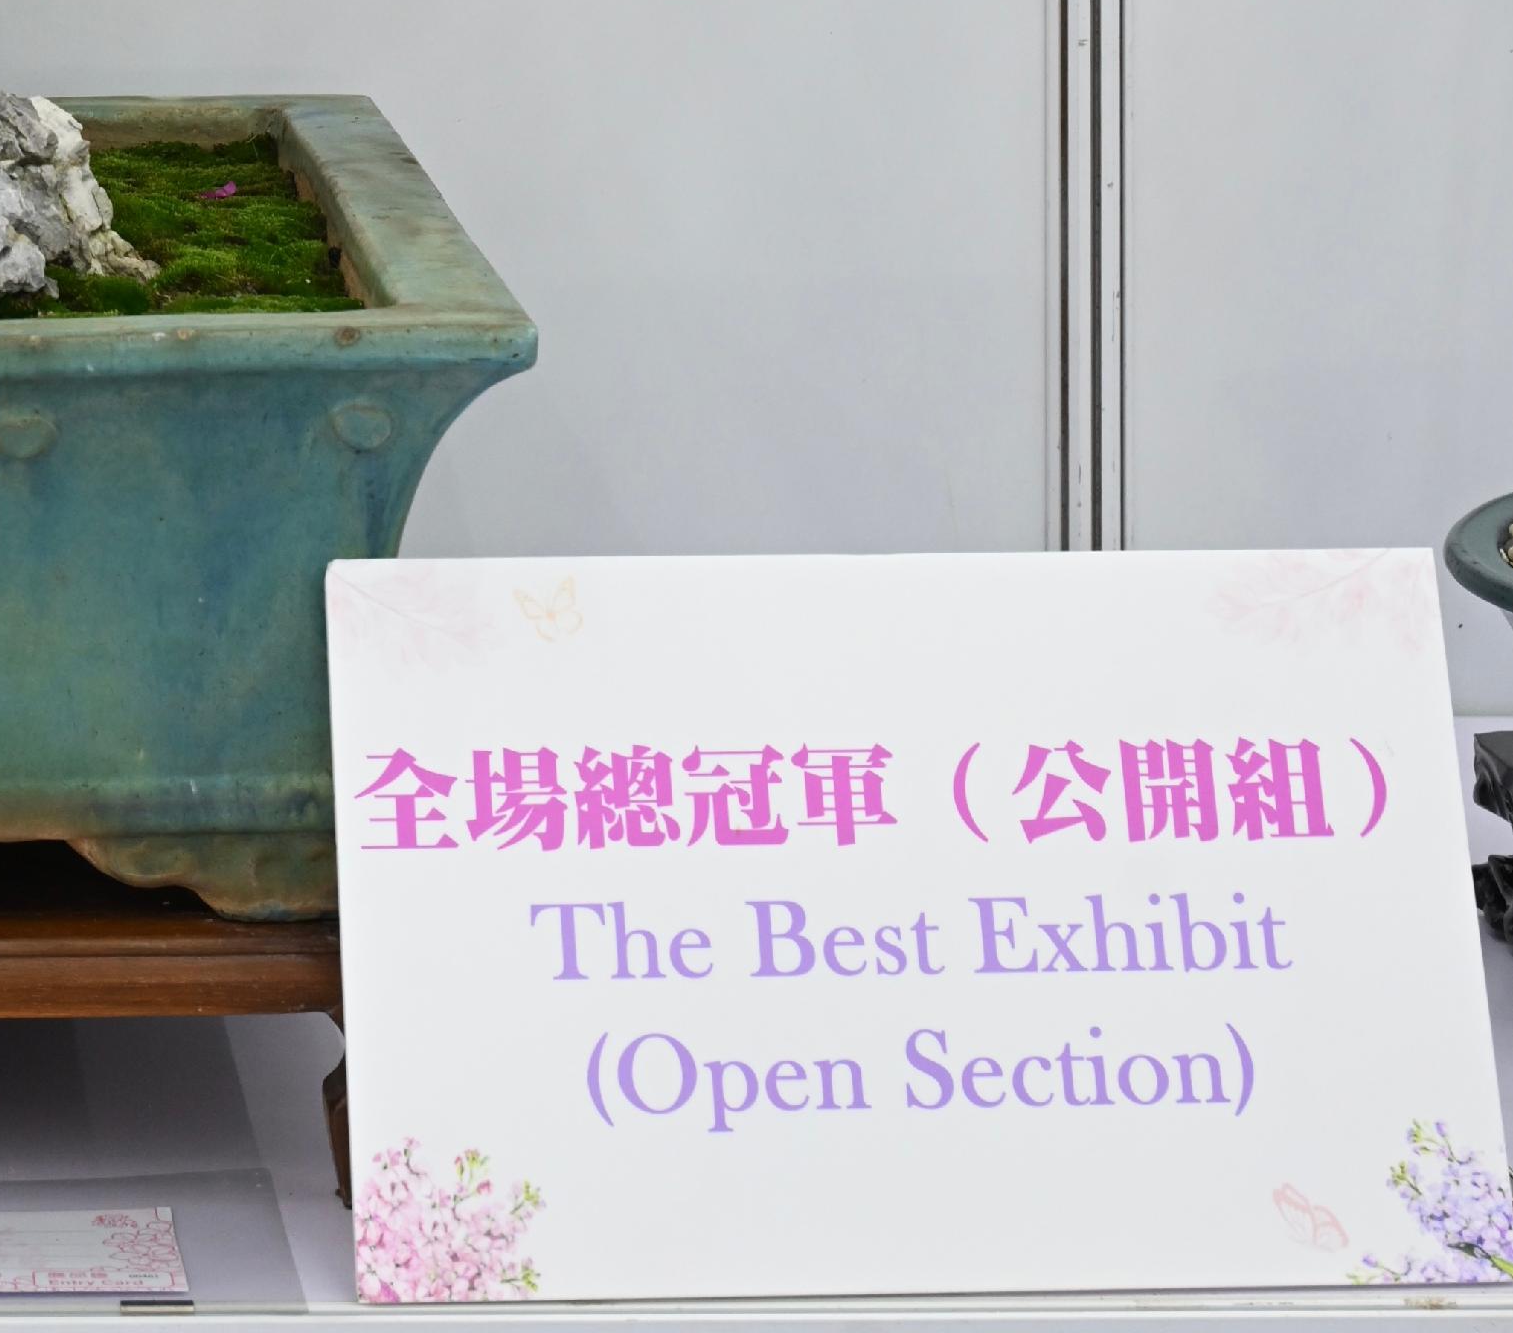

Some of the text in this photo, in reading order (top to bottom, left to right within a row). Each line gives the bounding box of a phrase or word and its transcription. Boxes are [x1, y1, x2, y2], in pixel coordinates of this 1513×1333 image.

[529, 891, 1293, 981] The Best Exhibit
[587, 1024, 1254, 1134] (Open Section)
